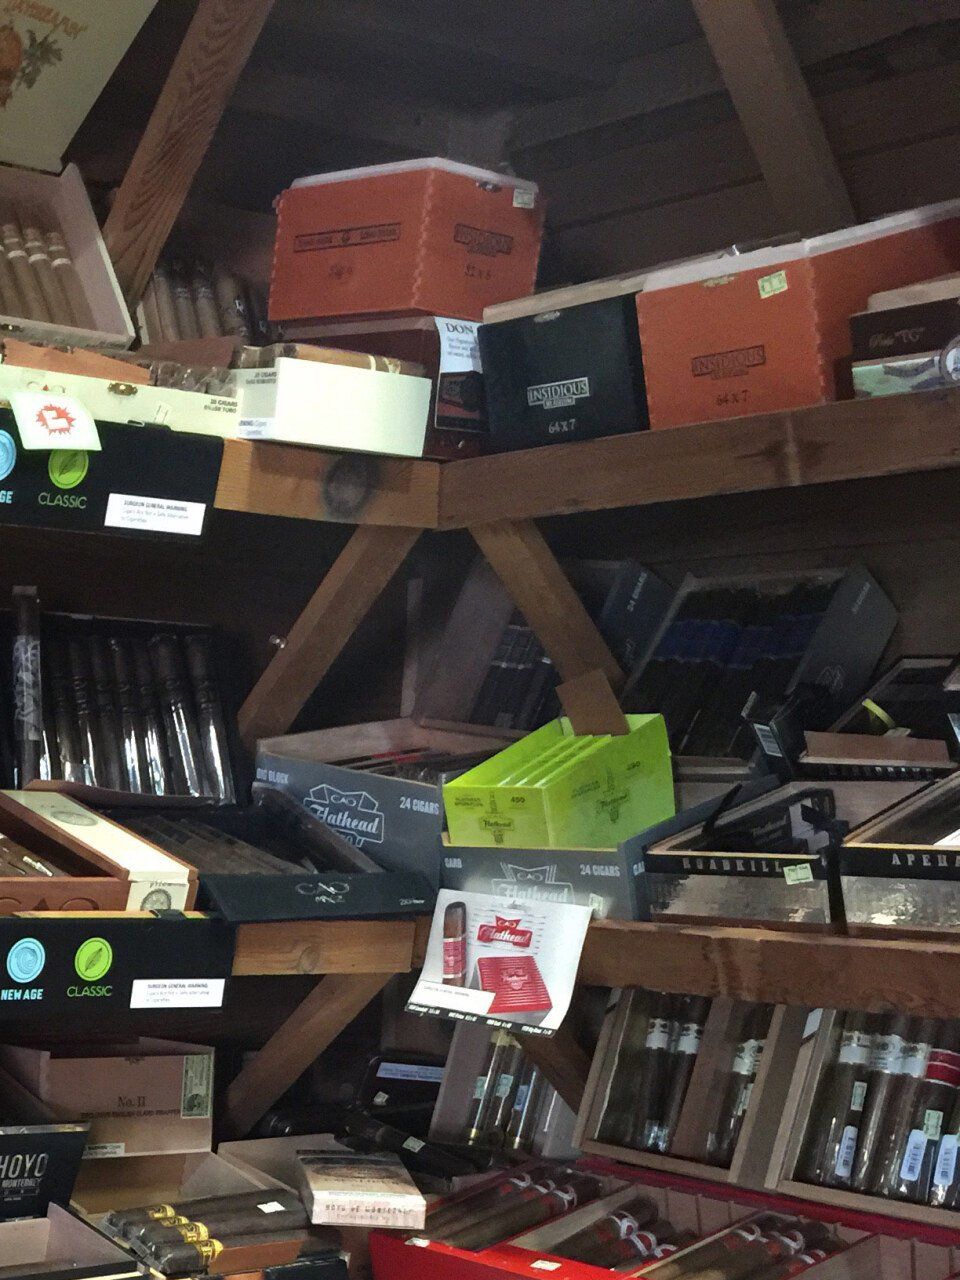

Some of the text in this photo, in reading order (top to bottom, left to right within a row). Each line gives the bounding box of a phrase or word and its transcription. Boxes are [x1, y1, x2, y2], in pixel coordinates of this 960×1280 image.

[528, 379, 589, 401] INSIDIOUS
[38, 492, 88, 510] CLASSIC
[330, 794, 357, 807] CAO
[399, 797, 440, 816] 24 CIGARS
[309, 804, 379, 835] Flathead
[580, 864, 621, 878] 24 CIGARS
[0, 988, 44, 1001] NEW AGE
[67, 985, 113, 998] CLASSIC
